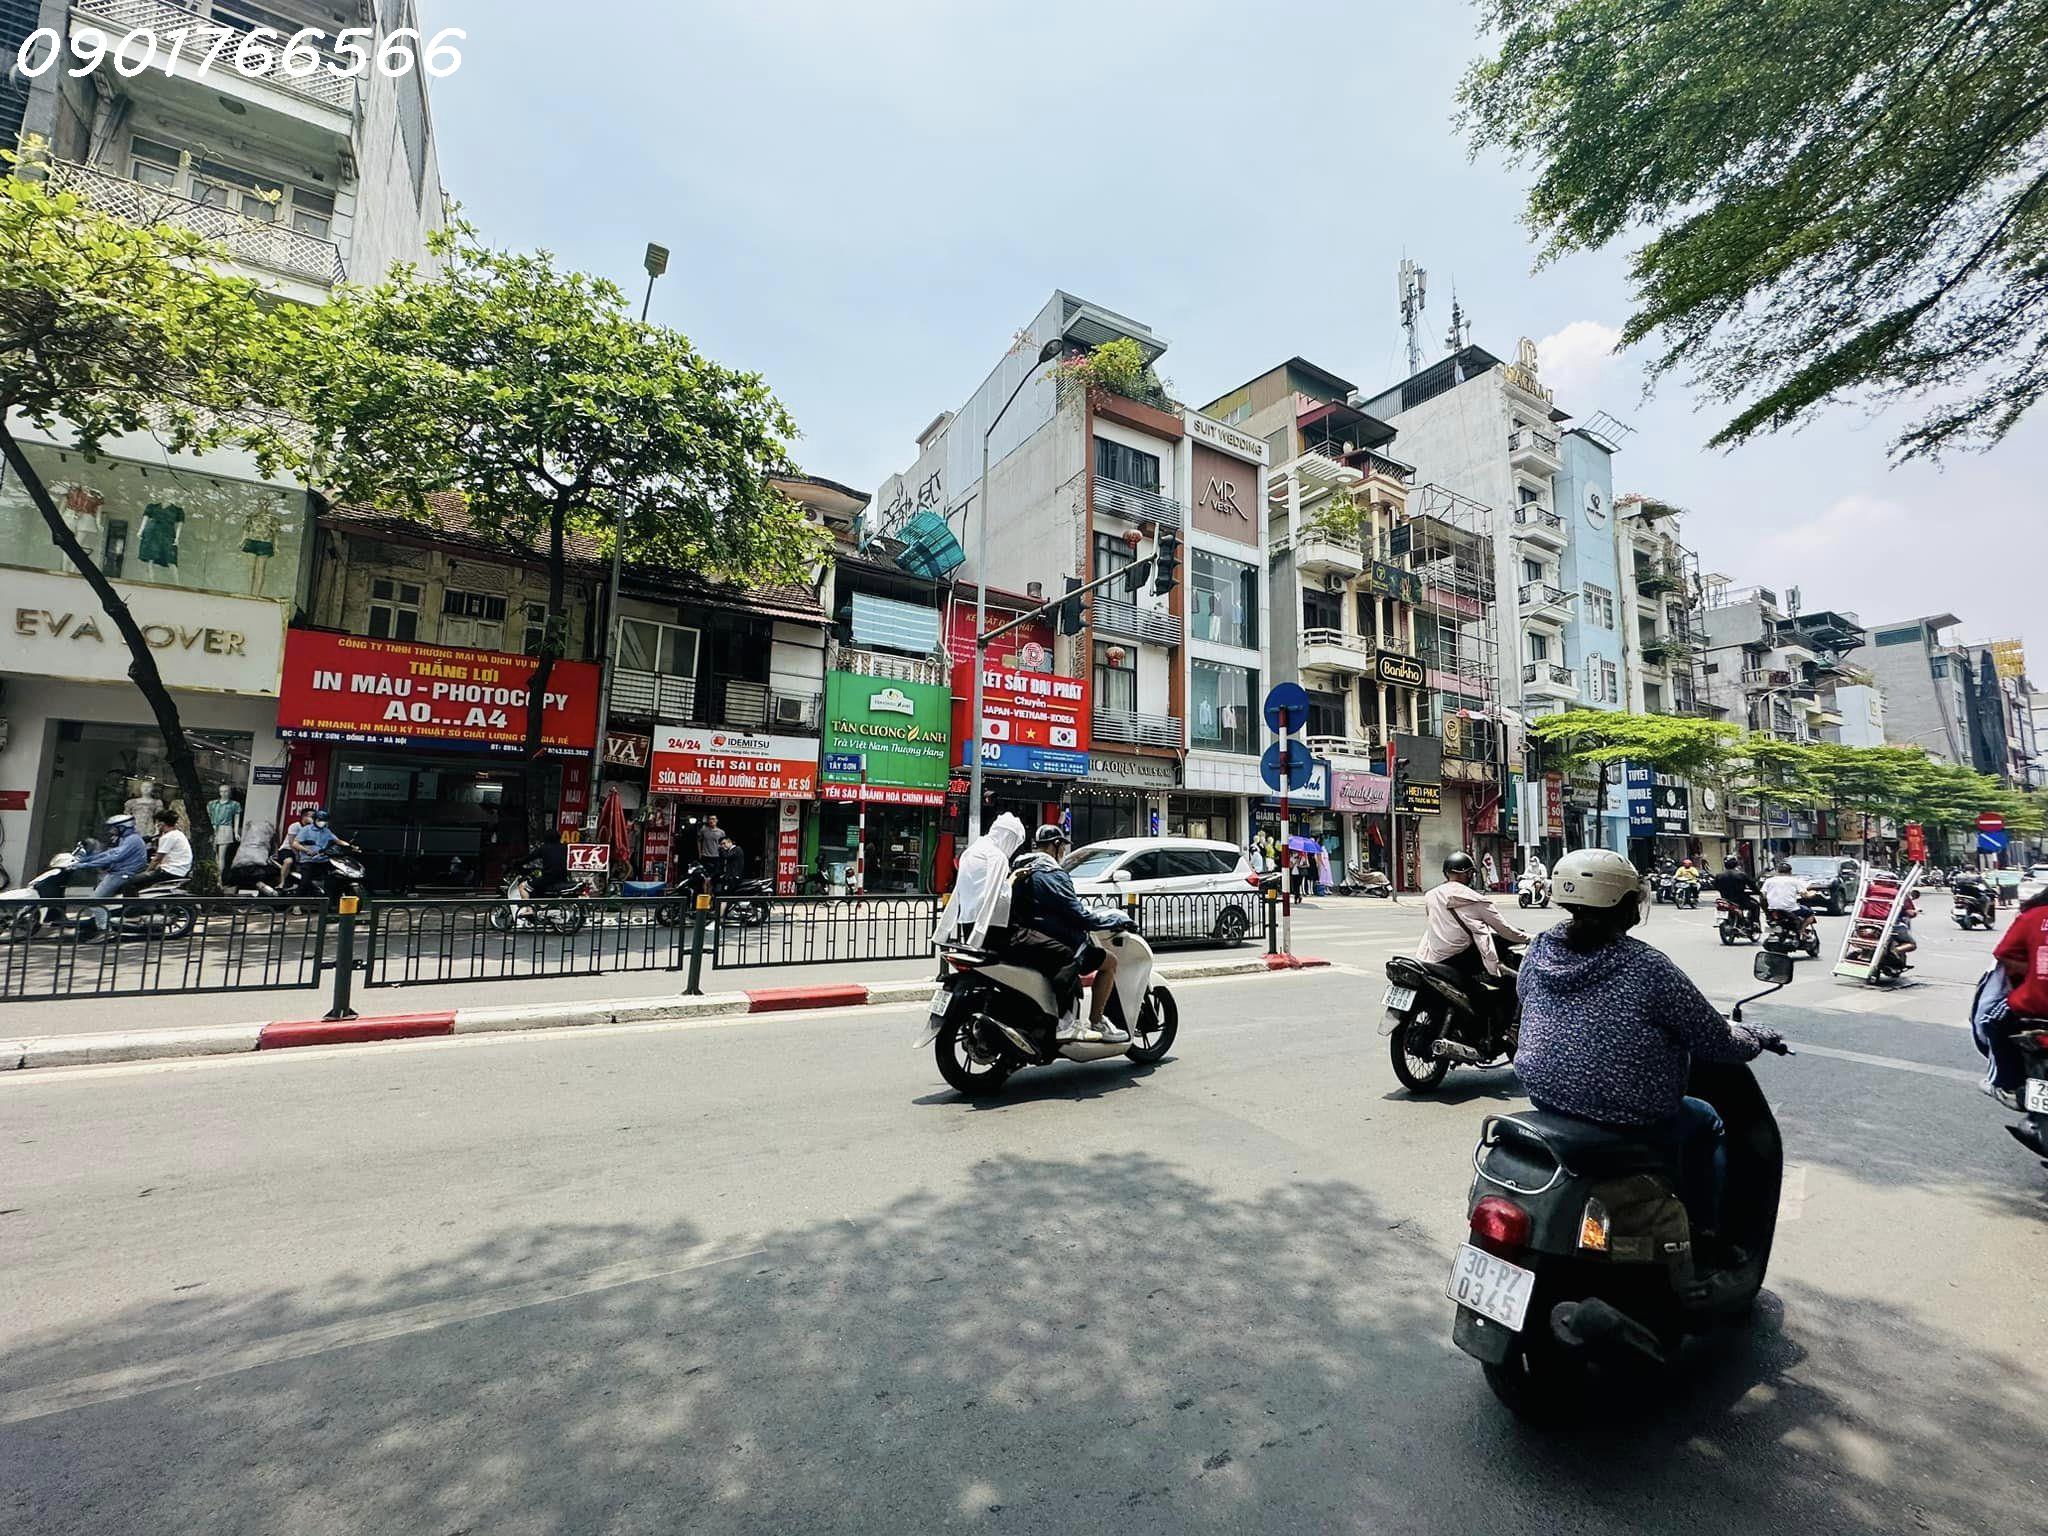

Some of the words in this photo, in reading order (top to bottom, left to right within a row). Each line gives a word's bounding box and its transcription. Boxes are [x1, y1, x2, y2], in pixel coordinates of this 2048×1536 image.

[1194, 420, 1218, 437] SUIT
[1218, 428, 1263, 456] WEDDING
[1211, 499, 1234, 514] VEST
[15, 607, 104, 642] EVA
[121, 623, 247, 657] OVER
[338, 638, 367, 649] CÔNG
[371, 643, 383, 651] TY
[386, 644, 411, 654] TNHH
[415, 647, 452, 659] THƯƠNG
[455, 652, 474, 662] MẠI
[477, 653, 488, 663] VÀ
[491, 656, 512, 666] DỊCH
[515, 658, 527, 668] VỤ
[408, 659, 468, 680] THẮNG
[473, 668, 499, 684] LỢI
[312, 670, 343, 691] IN
[350, 672, 412, 697] MÀU
[432, 682, 569, 711] PHOTOCPY
[1004, 670, 1029, 692] SẮT
[1053, 682, 1083, 701] PHÁT
[1014, 696, 1047, 709] Chuyên
[302, 719, 315, 727] IN
[360, 722, 371, 731] IN
[832, 718, 858, 733] TÂN
[860, 723, 906, 739] CƯƠNG
[606, 737, 639, 760] VÁ
[667, 737, 701, 751] 24/24
[727, 738, 770, 749] IDEMITSU
[833, 737, 848, 747] Trà
[868, 742, 889, 752] Nam
[922, 746, 945, 759] Hạng
[304, 760, 315, 775] IN
[729, 758, 751, 771] SÀI
[755, 760, 782, 772] GÒN
[828, 761, 841, 770] TÂY
[843, 761, 857, 771] SƠN
[296, 778, 318, 796] MÀU
[658, 767, 677, 784] SỬA
[678, 769, 702, 786] CHỮA
[709, 770, 726, 787] BẢO
[757, 776, 768, 788] XE
[770, 777, 781, 789] GA
[787, 778, 798, 790] XE
[800, 774, 811, 790] SỐ
[825, 785, 841, 798] YẾN
[569, 845, 605, 865] VÁ
